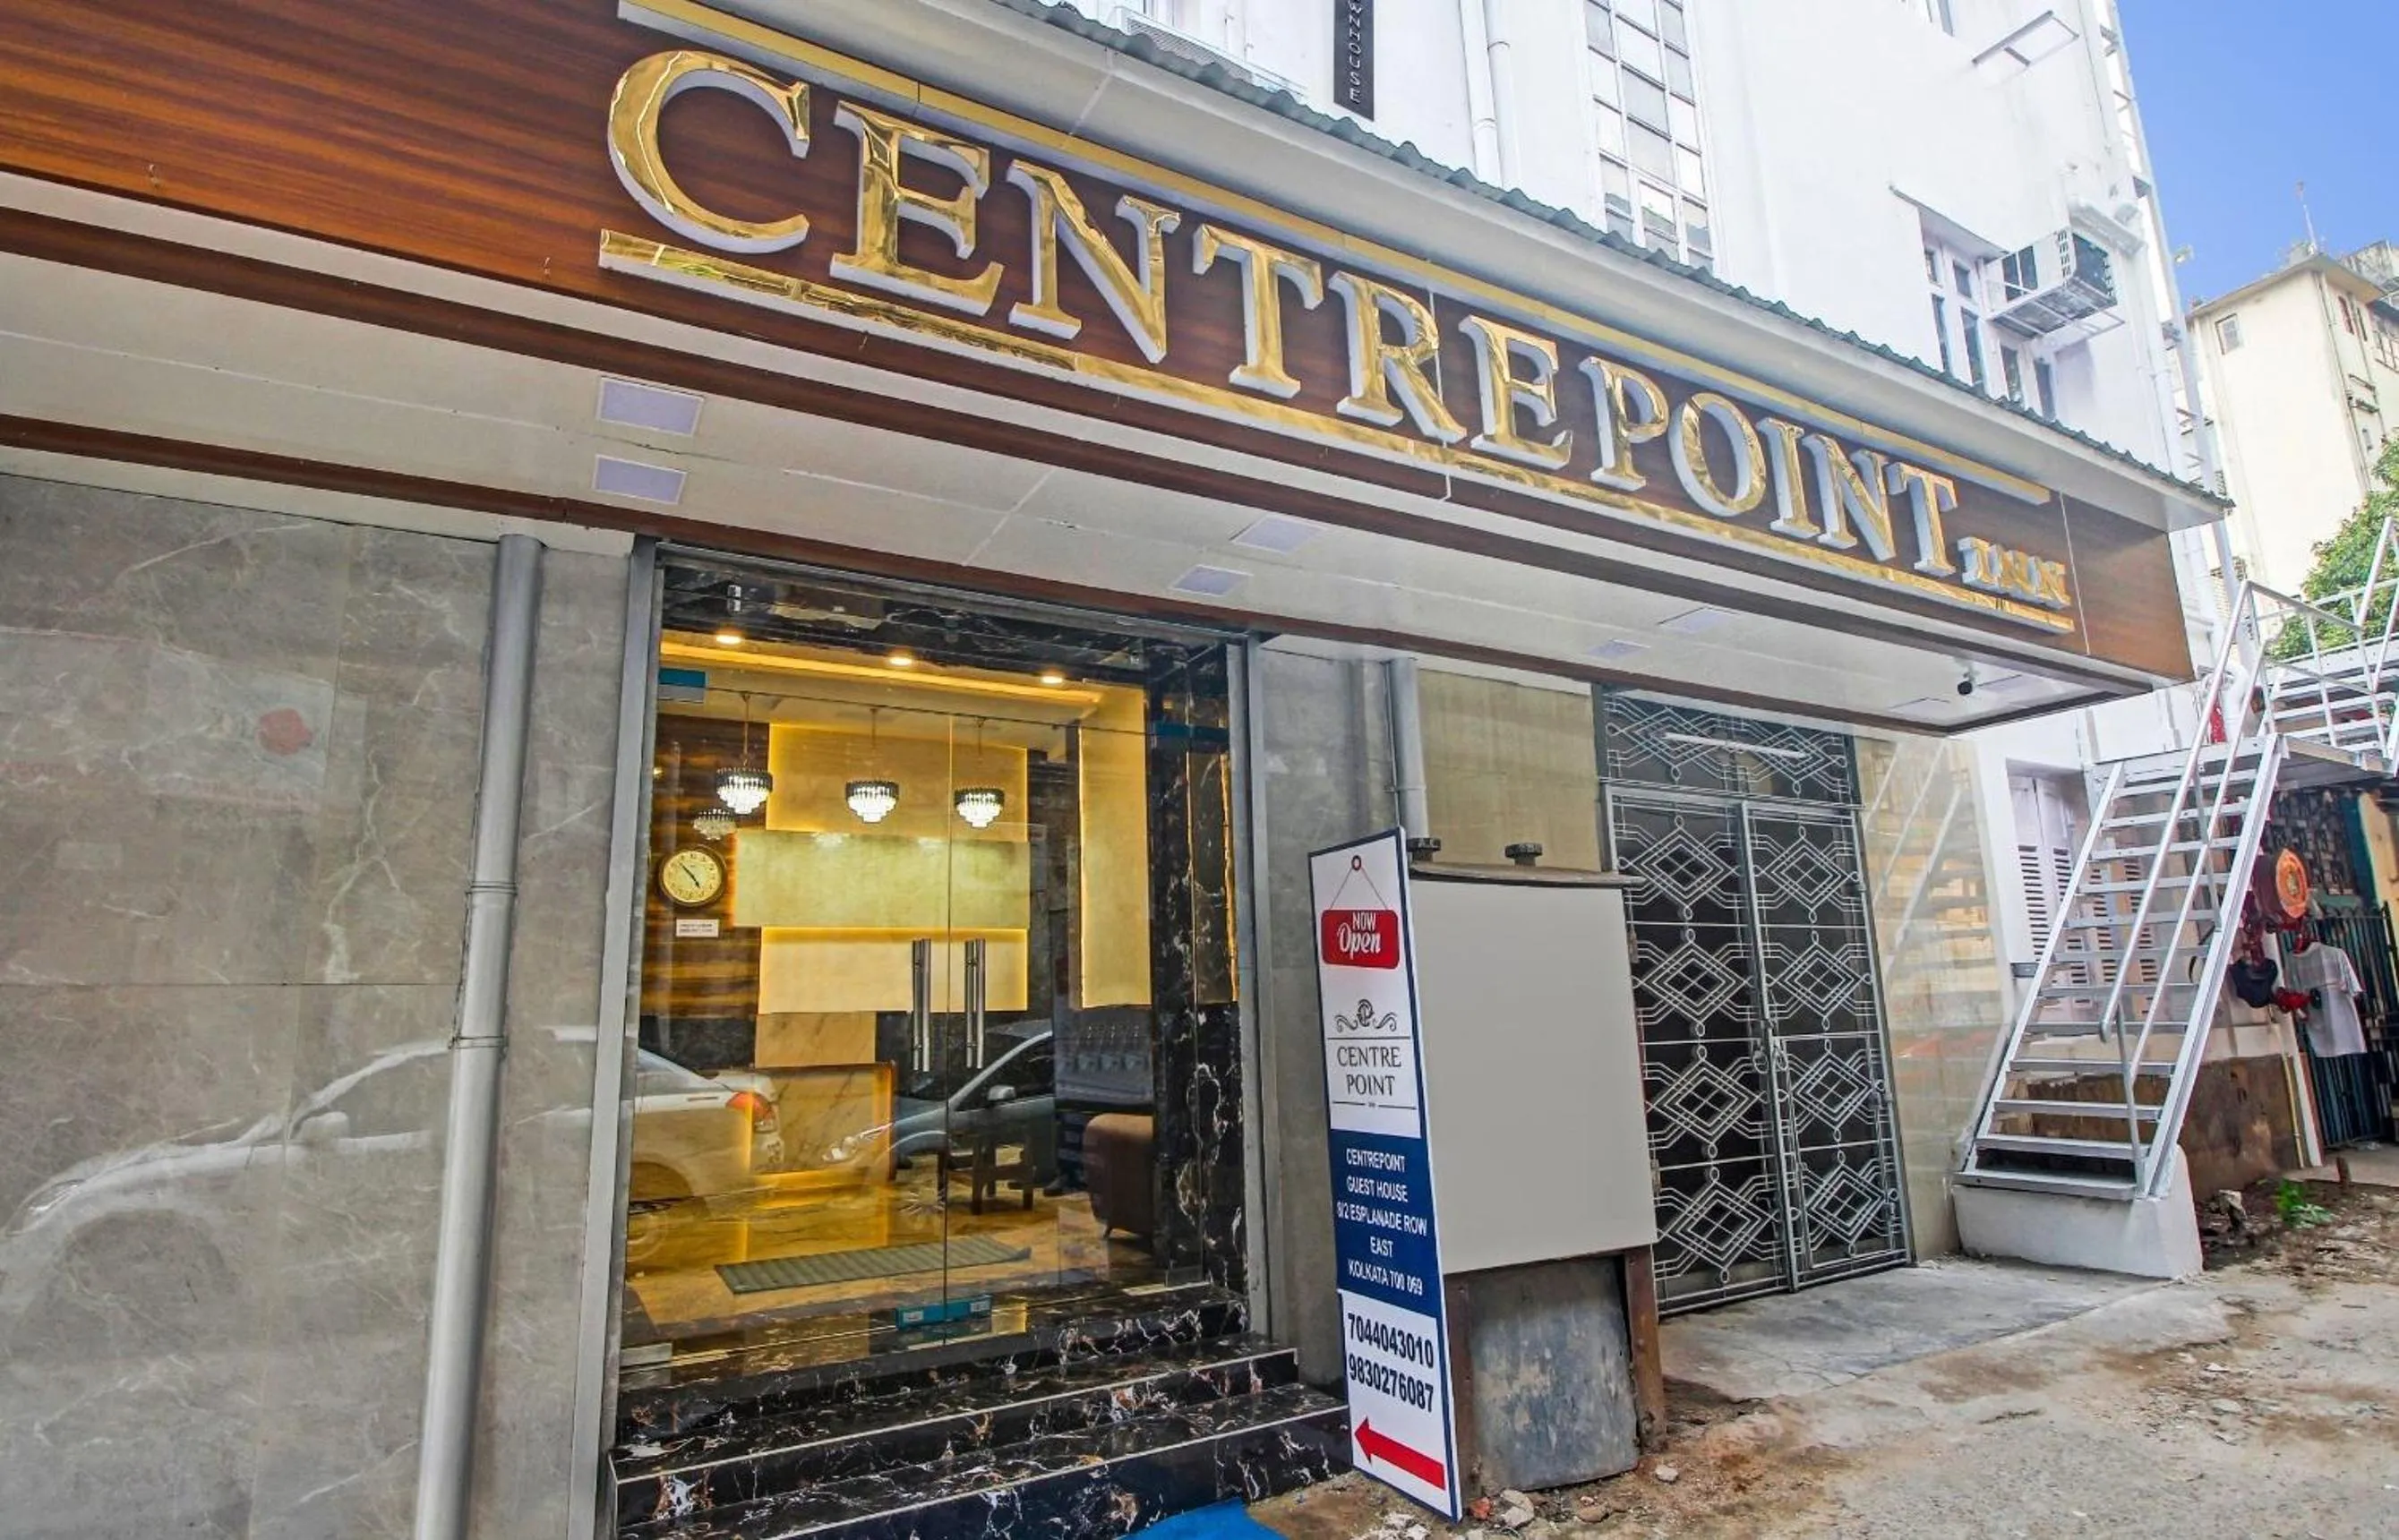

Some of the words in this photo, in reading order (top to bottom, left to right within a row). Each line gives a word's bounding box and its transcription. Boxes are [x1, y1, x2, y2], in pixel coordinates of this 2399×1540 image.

[607, 50, 1958, 578] CENTREPOINT
[1958, 536, 2071, 610] INN
[1352, 911, 1376, 931] NOW
[1337, 922, 1381, 961] Open
[1337, 1046, 1402, 1068] CENTRE
[1346, 1074, 1396, 1097] POINT
[1346, 1148, 1405, 1173] CENTREPOINT
[1346, 1176, 1375, 1197] GUEST
[1376, 1180, 1409, 1202] HOUSE
[1349, 1203, 1403, 1231] ESPLANADE
[1403, 1215, 1428, 1236] ROW
[1370, 1236, 1394, 1258] EAST
[1348, 1258, 1389, 1287] KOLKATA
[1390, 1270, 1405, 1291] 700
[1347, 1312, 1435, 1369] 7044043010
[1349, 1352, 1435, 1414] 9830276087
